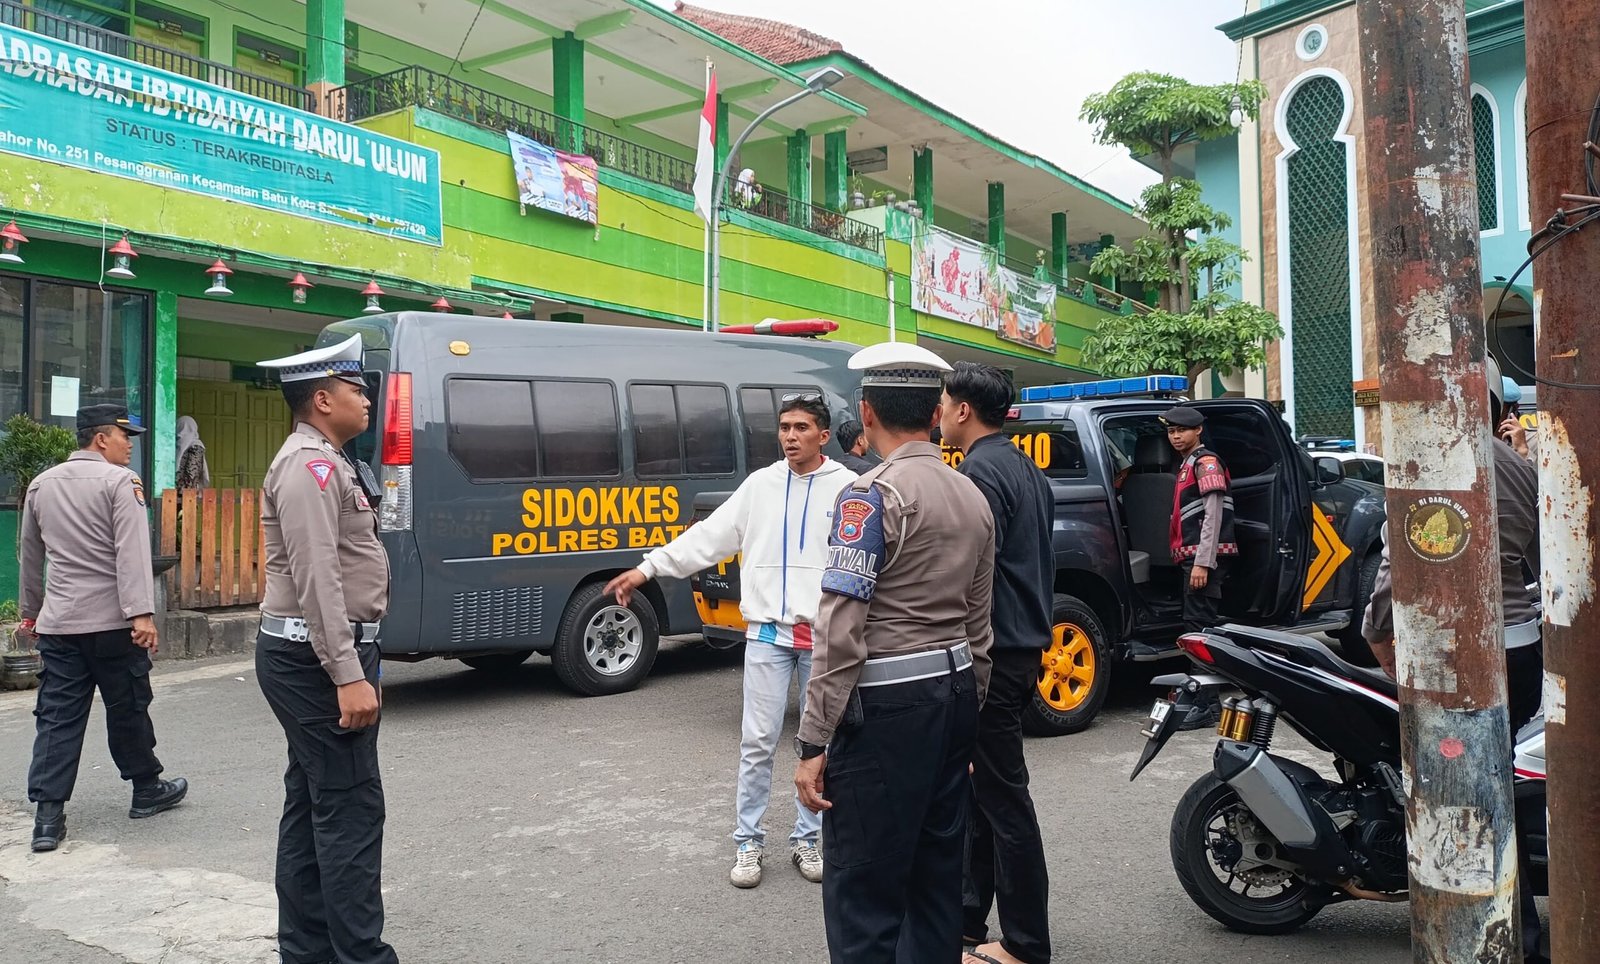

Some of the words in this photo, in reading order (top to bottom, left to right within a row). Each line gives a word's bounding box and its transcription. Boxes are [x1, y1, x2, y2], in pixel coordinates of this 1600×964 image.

[106, 118, 176, 147] STATUS
[142, 75, 286, 147] IBTIDAIYAH
[293, 118, 365, 167] DARUL
[37, 138, 61, 155] No.
[66, 145, 88, 162] 251
[192, 174, 259, 198] Kecamatan
[262, 188, 288, 204] Batu
[521, 485, 680, 529] SIDOKKES
[1428, 496, 1452, 506] DARUL
[1453, 503, 1469, 519] ULUM
[492, 527, 619, 556] POLRES
[628, 525, 688, 548] BAT
